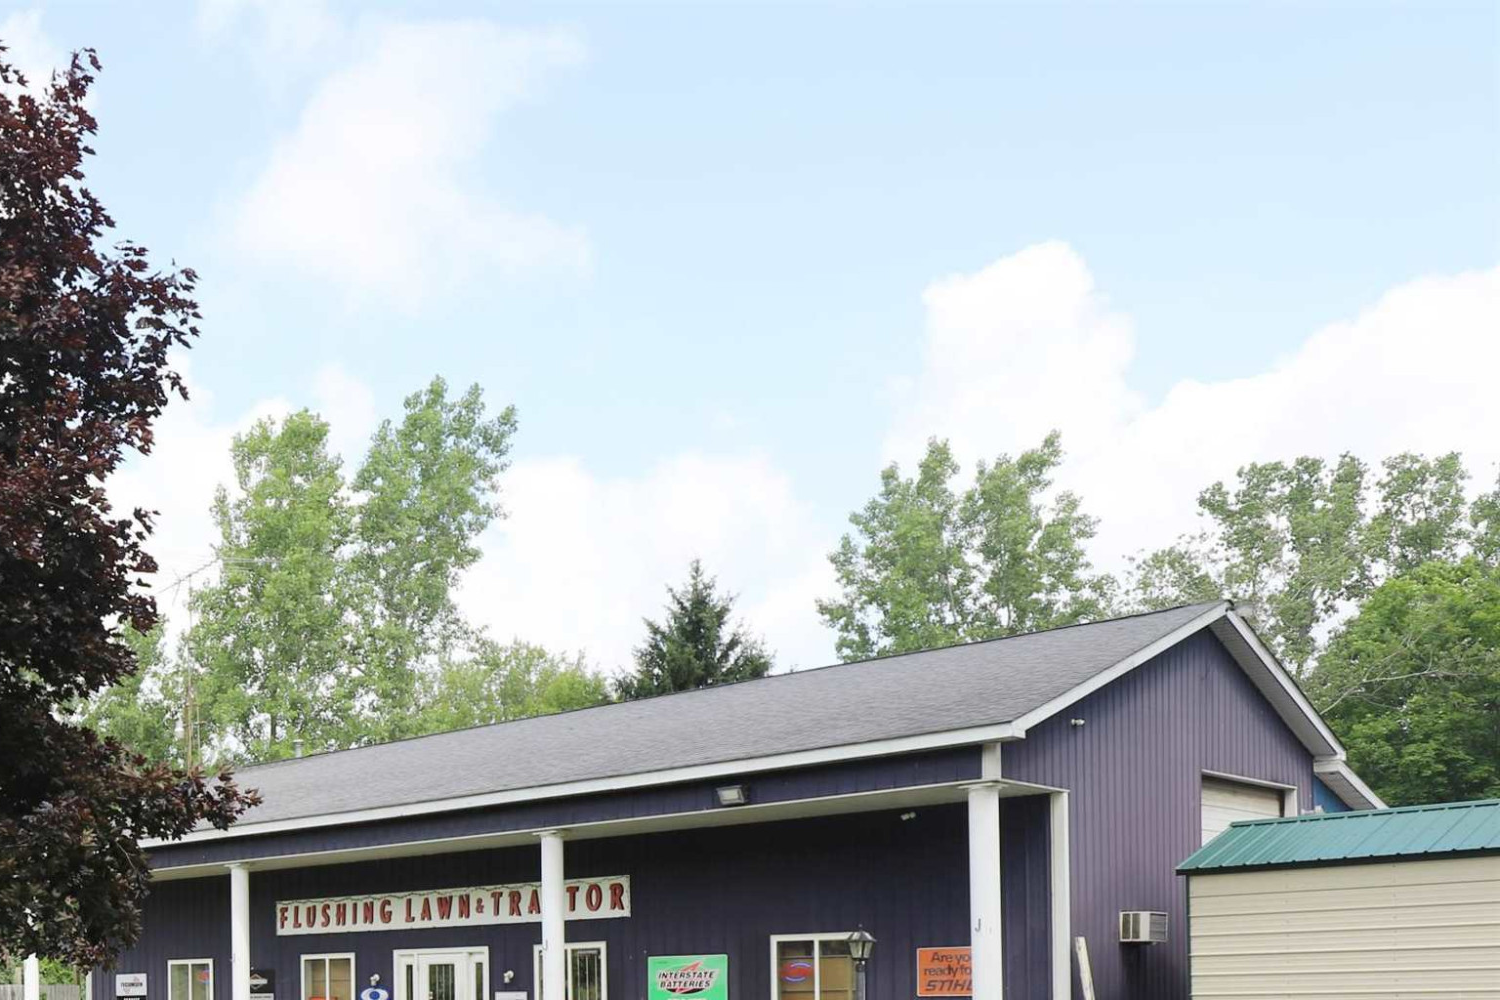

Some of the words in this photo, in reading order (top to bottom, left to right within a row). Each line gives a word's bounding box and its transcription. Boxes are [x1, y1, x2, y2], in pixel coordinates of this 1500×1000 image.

[279, 899, 393, 930] FLUSHING
[405, 893, 471, 923] LAWN
[475, 899, 485, 914] &
[491, 882, 625, 916] TRATOR
[931, 952, 953, 963] Are
[954, 953, 972, 965] yo
[658, 970, 716, 980] INTERSTATE
[924, 964, 958, 977] ready
[960, 965, 972, 976] fo
[660, 980, 711, 988] BATTERIES
